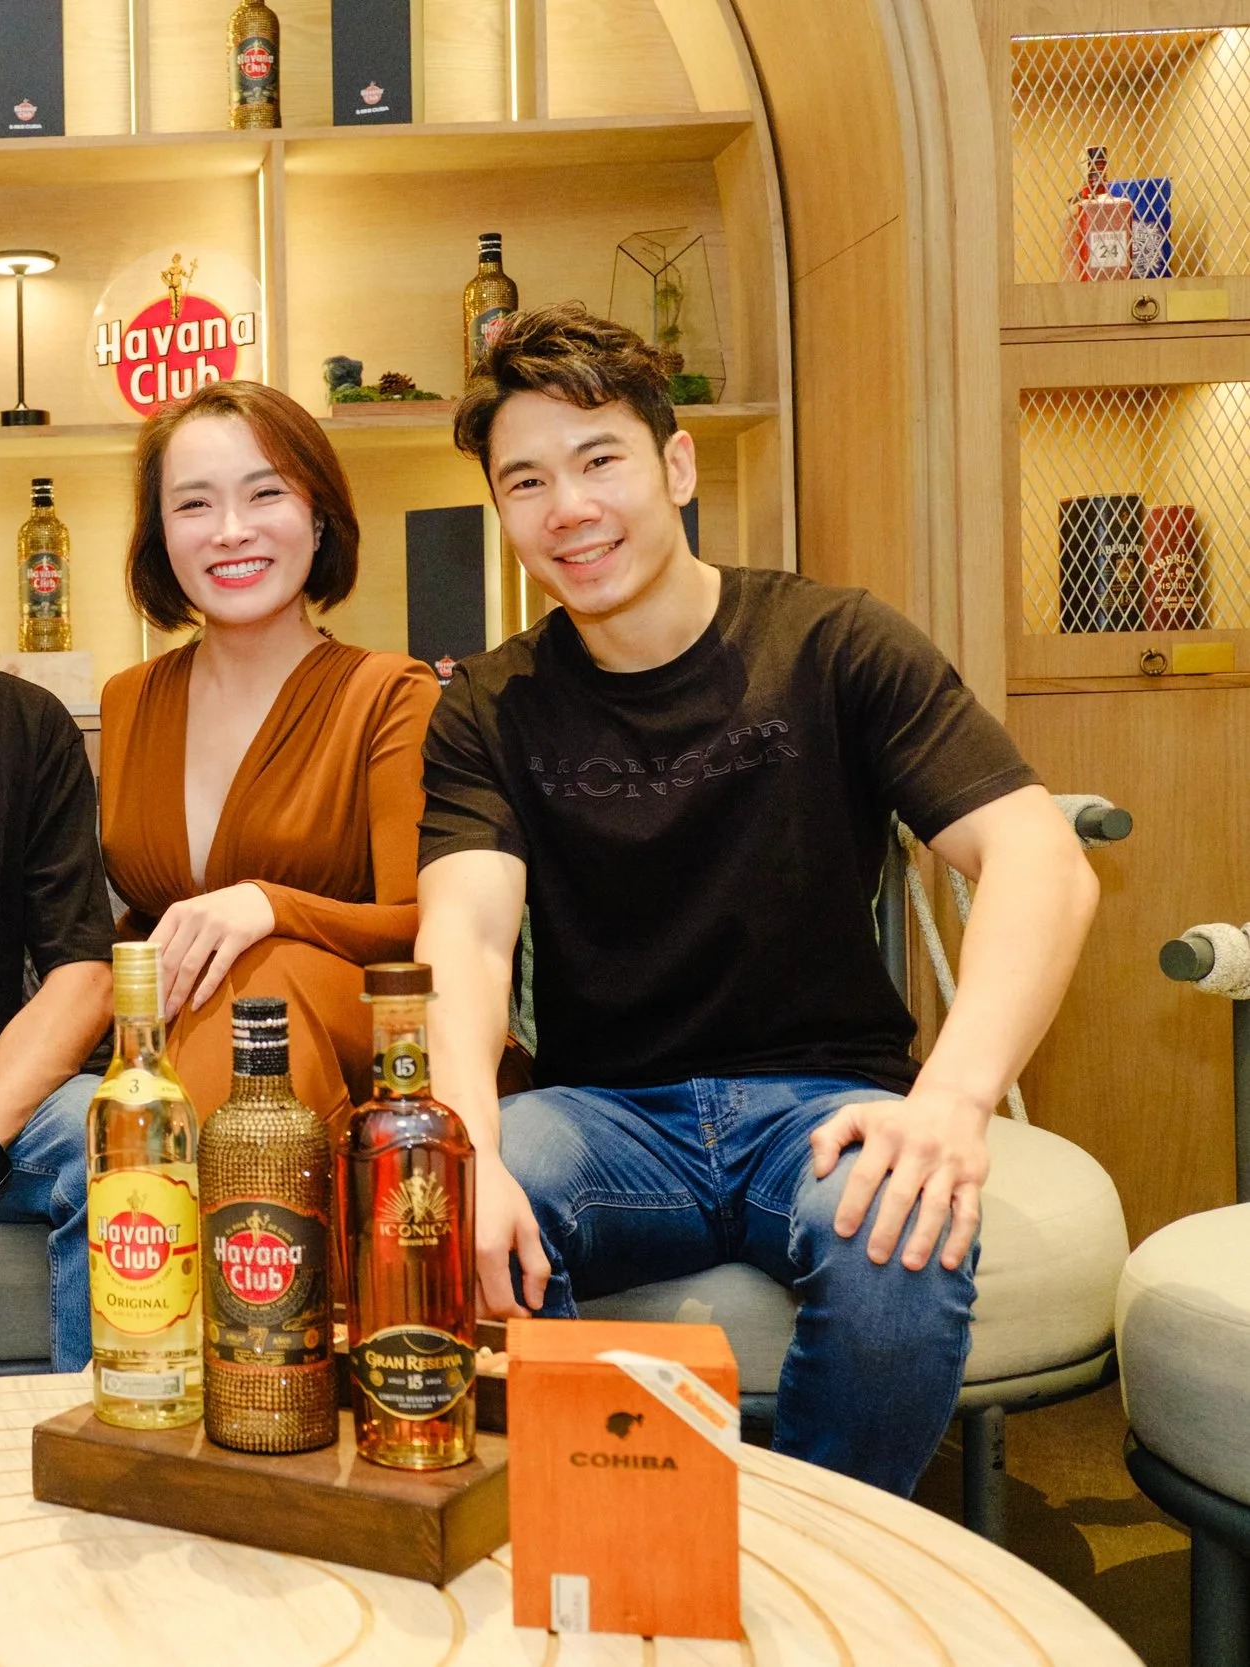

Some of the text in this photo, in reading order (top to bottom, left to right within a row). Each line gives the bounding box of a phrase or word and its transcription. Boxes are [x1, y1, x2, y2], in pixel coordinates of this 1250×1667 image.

[1100, 245, 1119, 258] 24
[94, 312, 256, 366] Havana
[130, 355, 221, 405] Club
[394, 1056, 416, 1077] 15
[128, 1079, 140, 1094] 3
[97, 1215, 179, 1244] Havana
[379, 1222, 452, 1238] ICONICA
[110, 1243, 162, 1270] Club
[214, 1235, 303, 1265] Havana
[230, 1264, 284, 1292] Club
[106, 1293, 170, 1309] ORIGINAL
[248, 1326, 269, 1352] 7
[365, 1350, 463, 1372] GRAN RESERVA
[407, 1373, 424, 1390] 15
[569, 1451, 679, 1471] COHIBA
